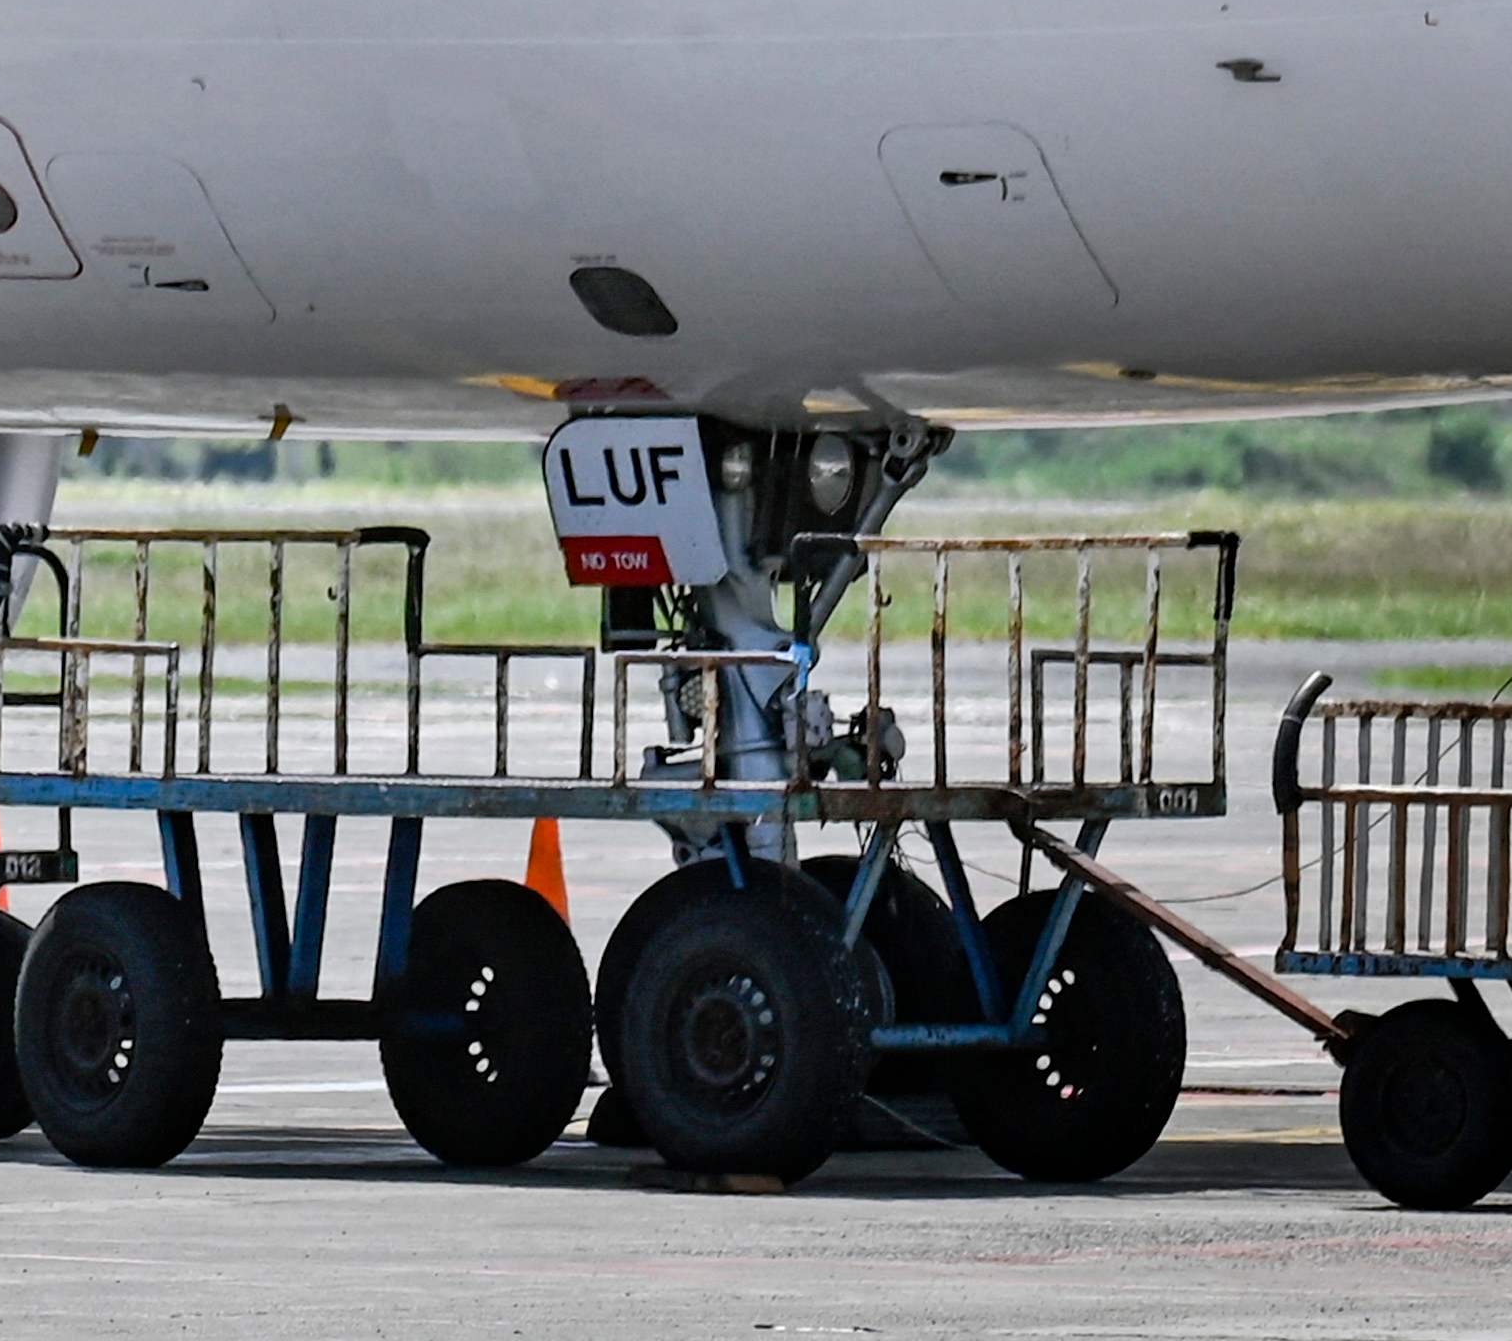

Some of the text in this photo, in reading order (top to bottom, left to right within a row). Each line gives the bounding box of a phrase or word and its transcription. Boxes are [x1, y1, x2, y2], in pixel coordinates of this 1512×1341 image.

[559, 446, 684, 507] LUF
[580, 551, 649, 571] NO TOW
[1159, 787, 1199, 814] 001
